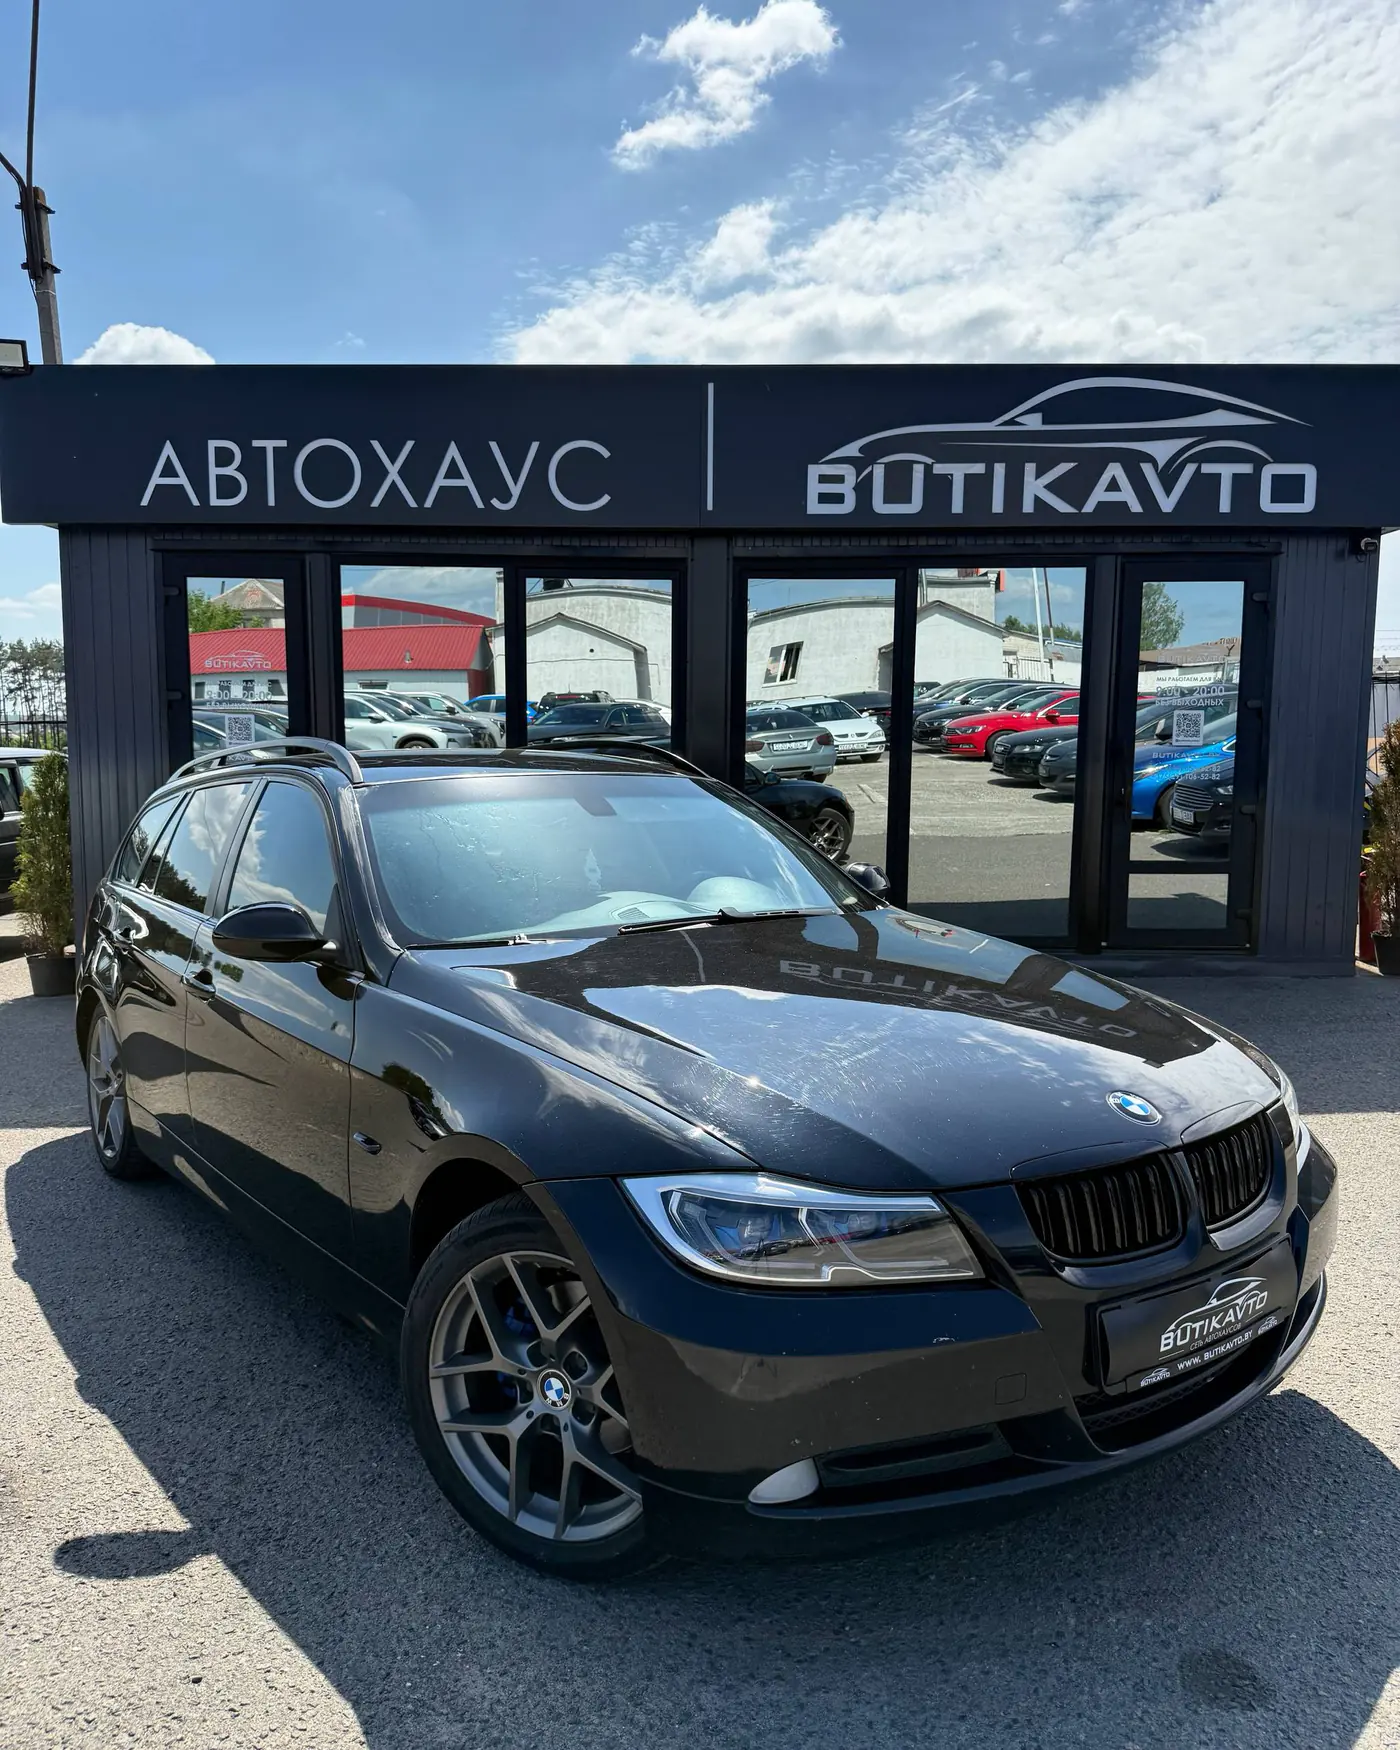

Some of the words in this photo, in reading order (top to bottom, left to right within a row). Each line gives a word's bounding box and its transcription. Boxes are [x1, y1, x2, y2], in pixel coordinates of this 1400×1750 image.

[140, 438, 611, 511] АВТОХАУС
[807, 462, 1317, 514] BUTIKAVTO
[204, 659, 272, 669] BUTIKAVTO
[206, 690, 230, 700] 9:00
[242, 690, 273, 700] 20:00
[1156, 686, 1180, 697] 9:00
[1193, 686, 1225, 696] 20:00
[1160, 1291, 1268, 1352] BUTIKAVTO
[1189, 1339, 1204, 1351] СЕТЬ
[1204, 1322, 1242, 1345] АВТОХАУСОВ
[1177, 1356, 1202, 1371] WWW.
[1204, 1330, 1253, 1361] BUTIKAVTO.BY
